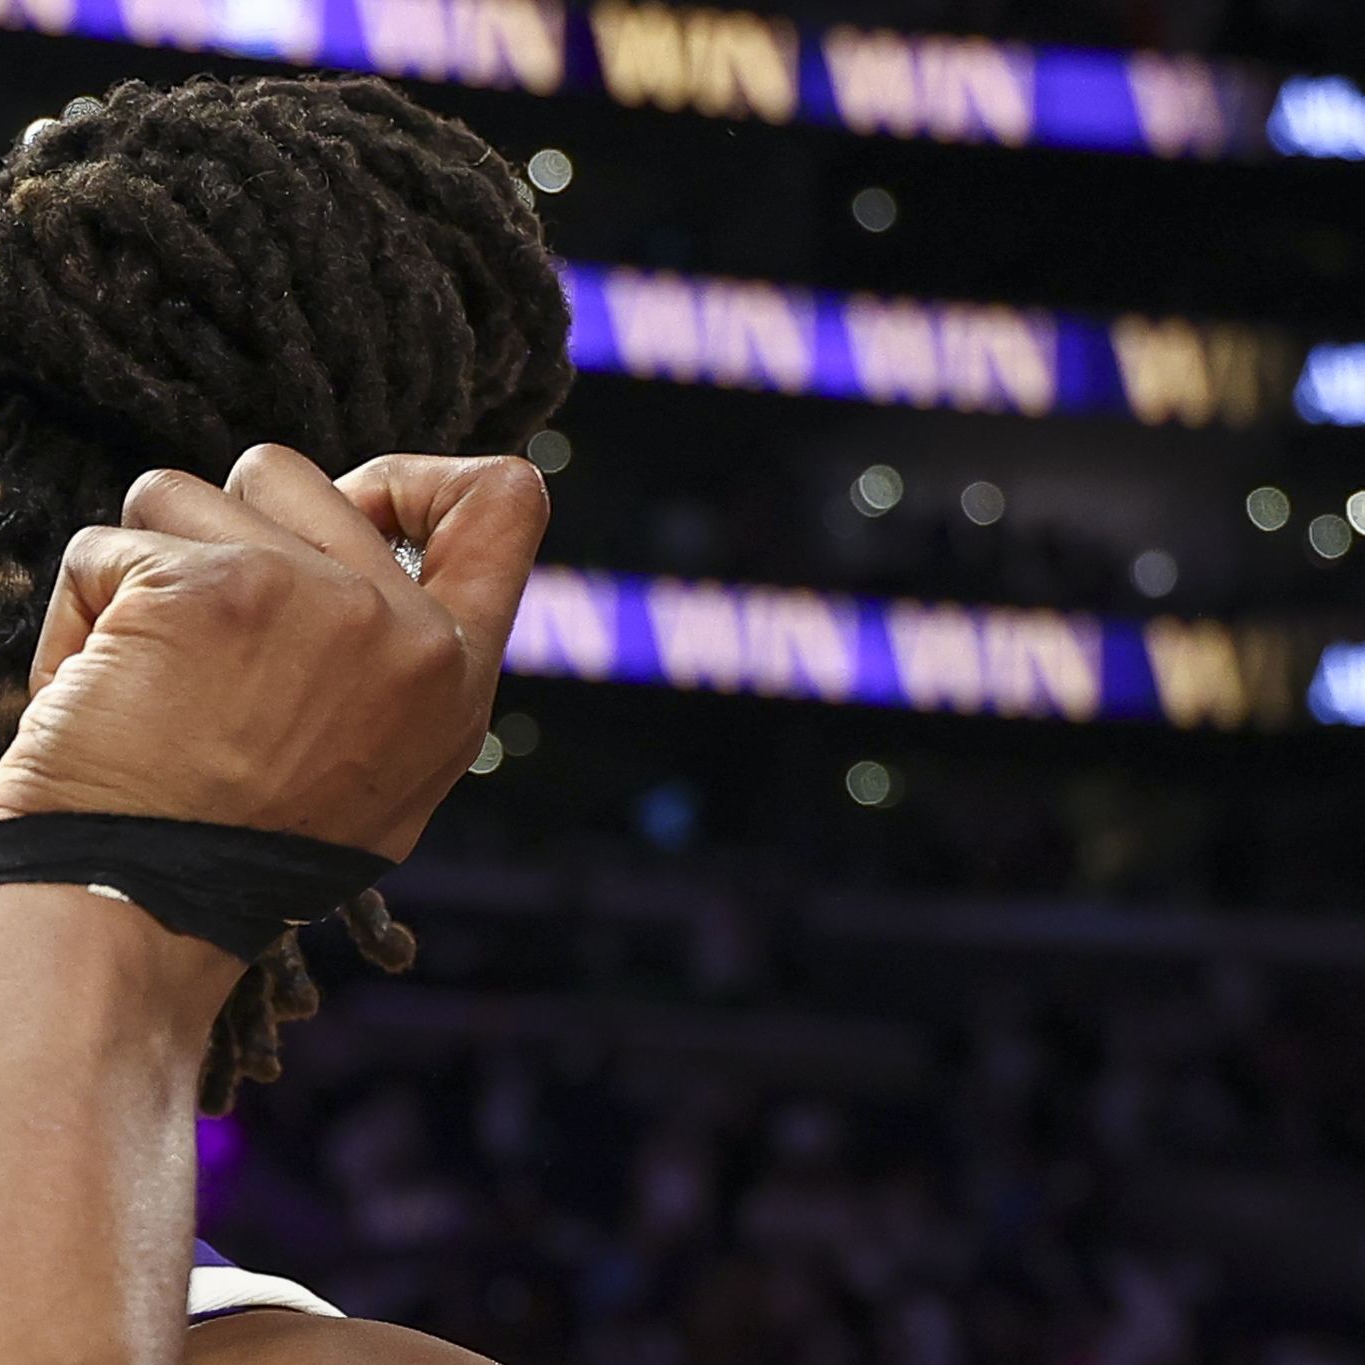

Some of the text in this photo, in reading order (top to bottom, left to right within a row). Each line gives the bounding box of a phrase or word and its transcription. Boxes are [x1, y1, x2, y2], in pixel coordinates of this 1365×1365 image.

[590, 0, 797, 125] WIN
[823, 24, 1034, 147] WIN
[603, 268, 817, 396] WIN
[843, 292, 1057, 418] WIN
[645, 577, 860, 705] WIN
[885, 600, 1102, 724] WIN
